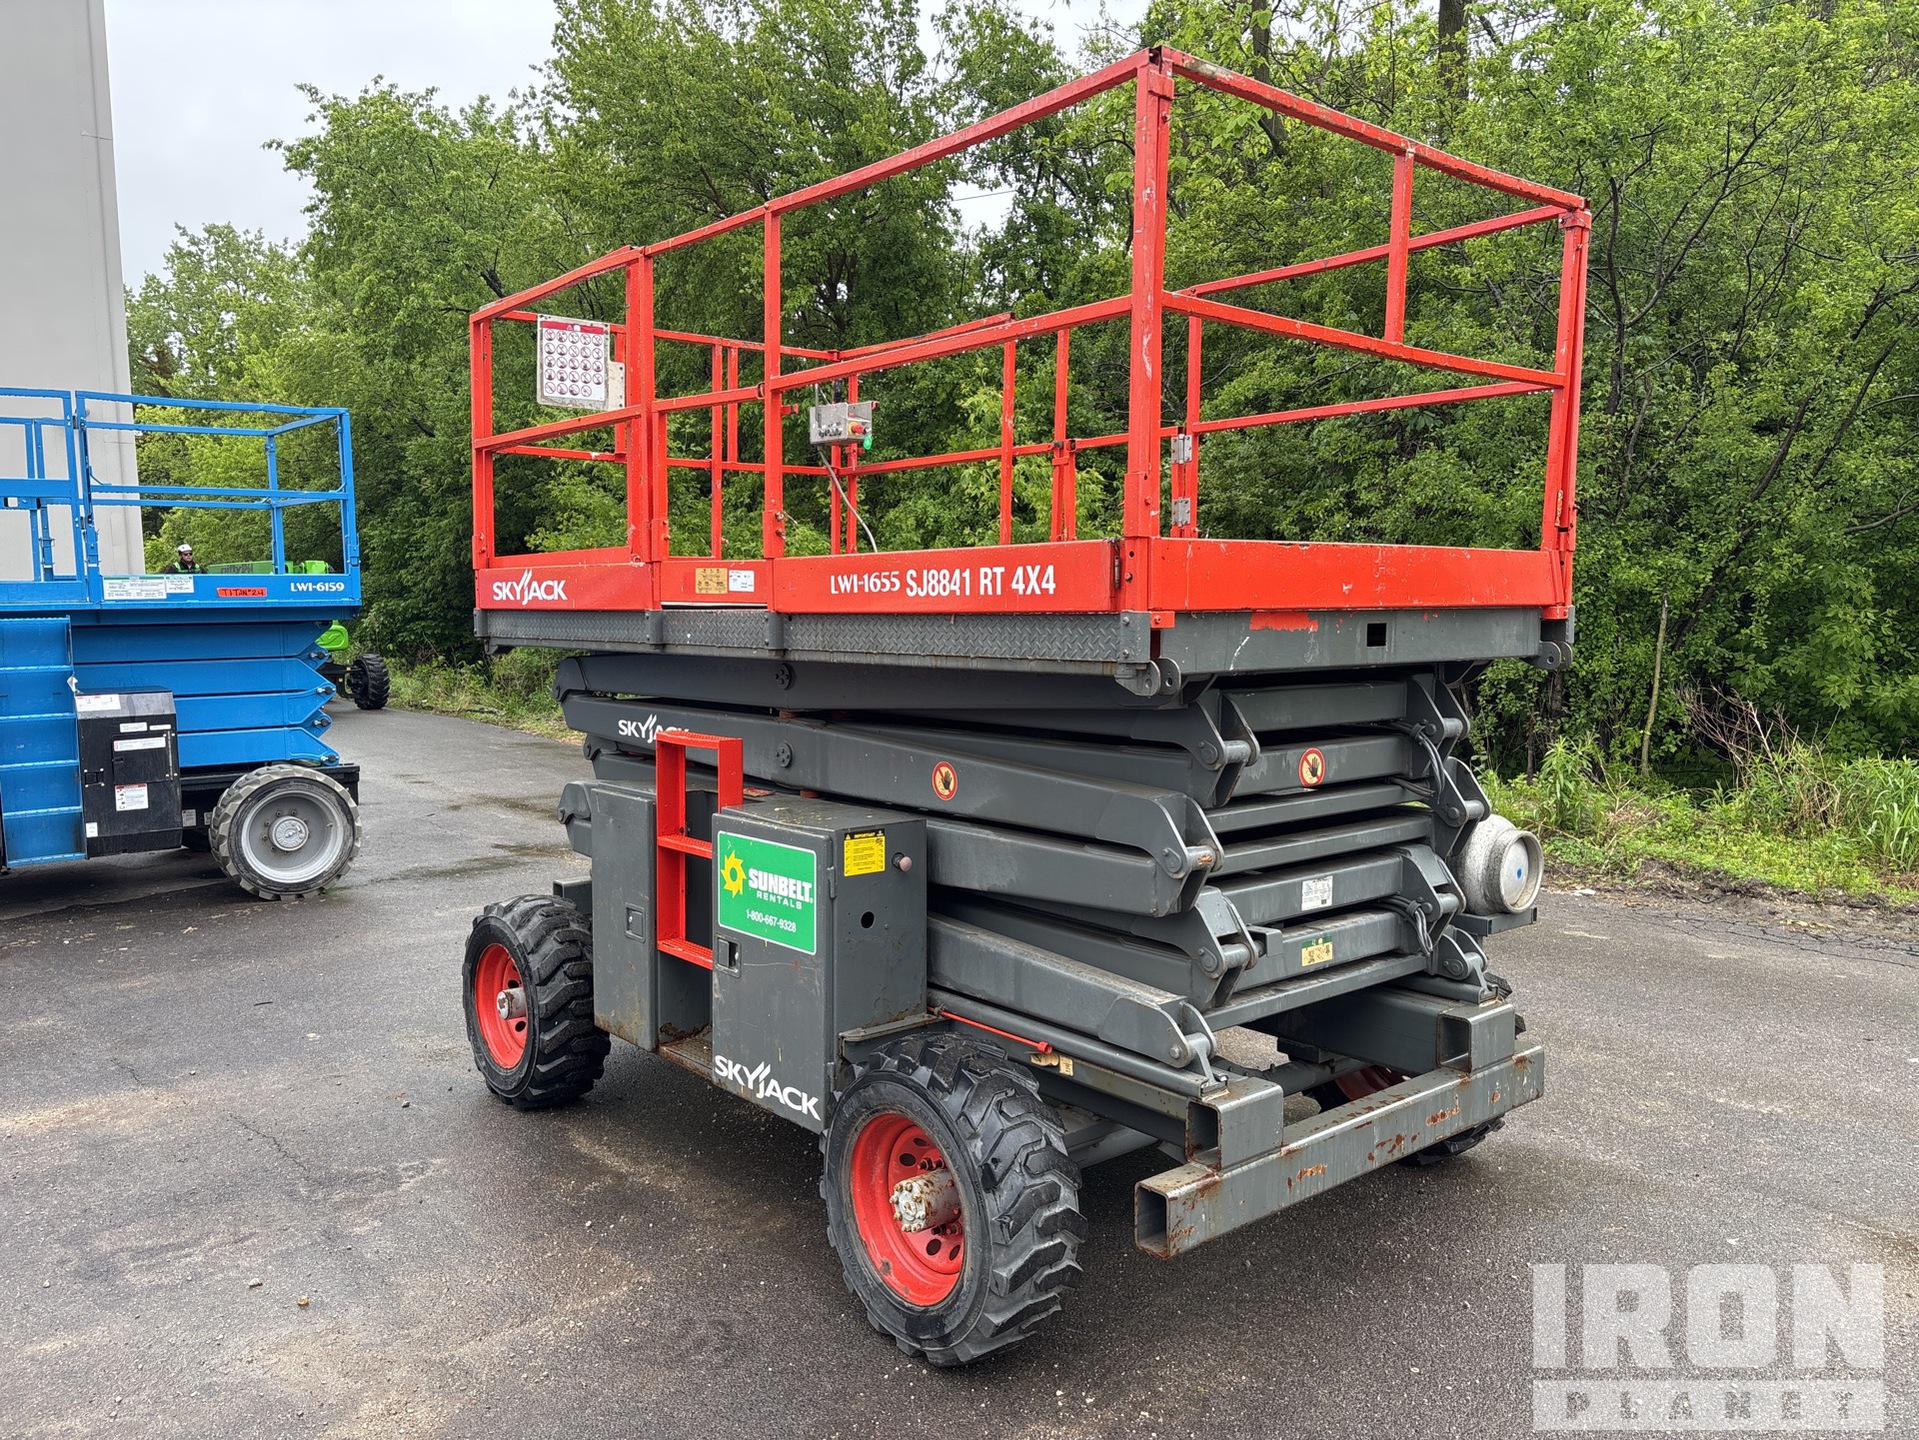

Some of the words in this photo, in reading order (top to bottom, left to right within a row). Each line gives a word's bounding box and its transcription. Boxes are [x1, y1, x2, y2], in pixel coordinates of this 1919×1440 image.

[290, 581, 345, 592] LWI-6159
[492, 568, 568, 605] SKYJACK
[830, 571, 900, 594] LWI-1655
[906, 568, 971, 597] SJ8841
[979, 567, 1005, 596] RT
[1011, 565, 1056, 595] 4X4
[618, 713, 689, 744] SKYJA
[748, 868, 812, 903] SUNBELT
[756, 890, 802, 910] RENTALS
[714, 1054, 821, 1121] SKYJACK
